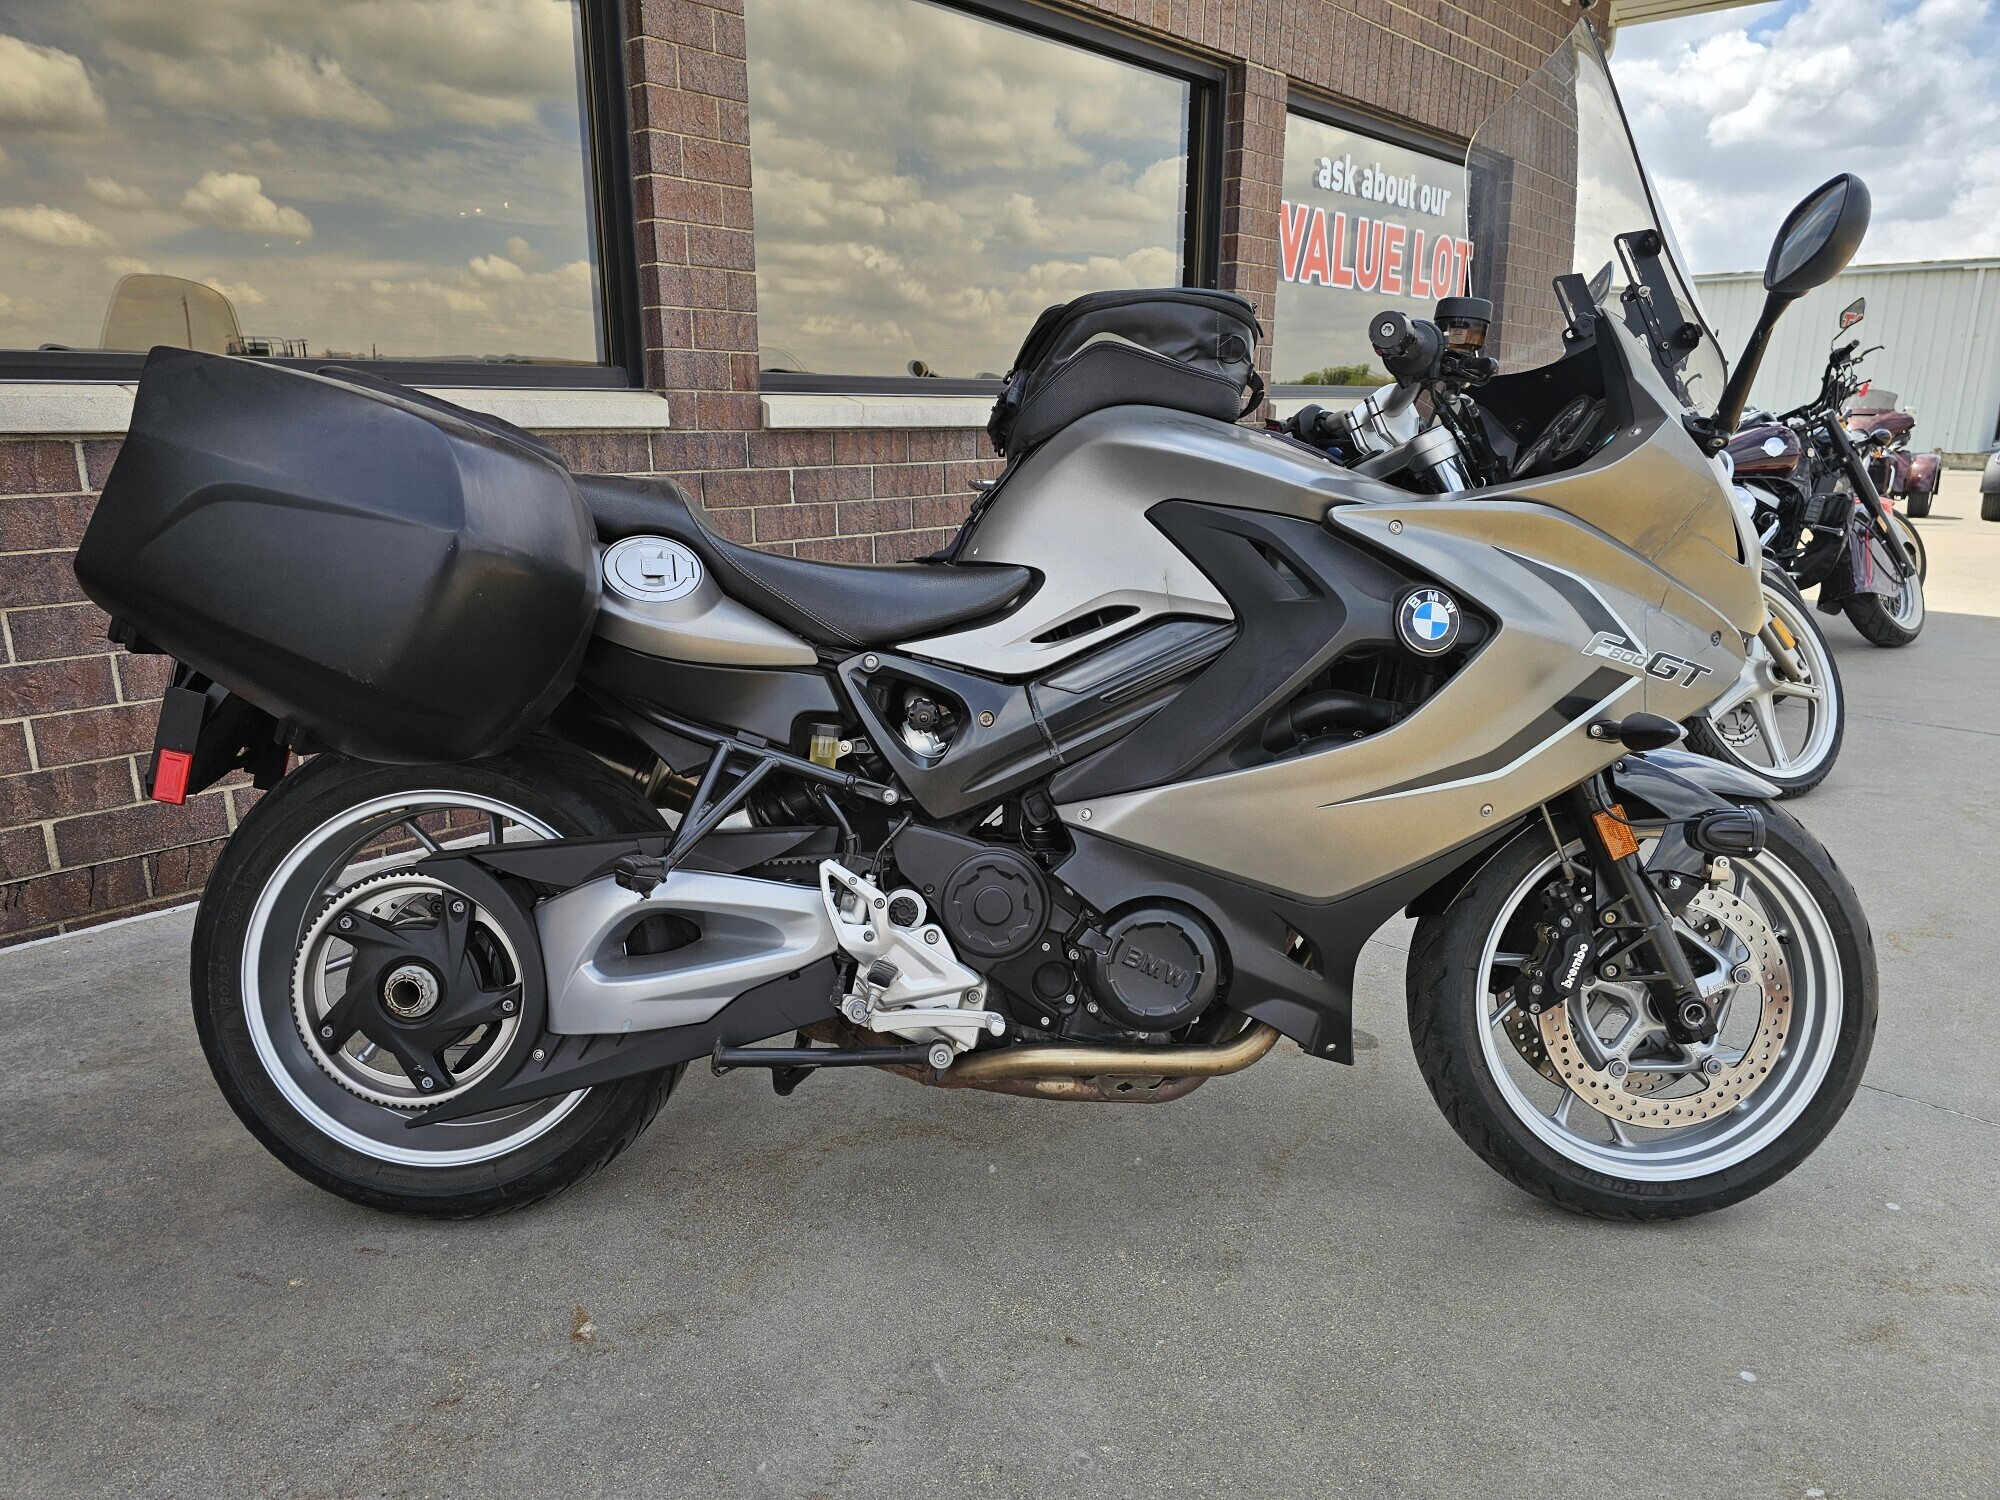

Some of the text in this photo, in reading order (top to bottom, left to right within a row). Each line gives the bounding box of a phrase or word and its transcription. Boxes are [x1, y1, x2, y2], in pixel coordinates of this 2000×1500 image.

[1318, 154, 1451, 217] ask about our
[1280, 200, 1474, 299] VALUE LOT
[1407, 591, 1456, 614] BMW
[1122, 945, 1189, 988] BMW
[1561, 943, 1589, 989] brembo
[1570, 1166, 1664, 1196] MICHELIN
